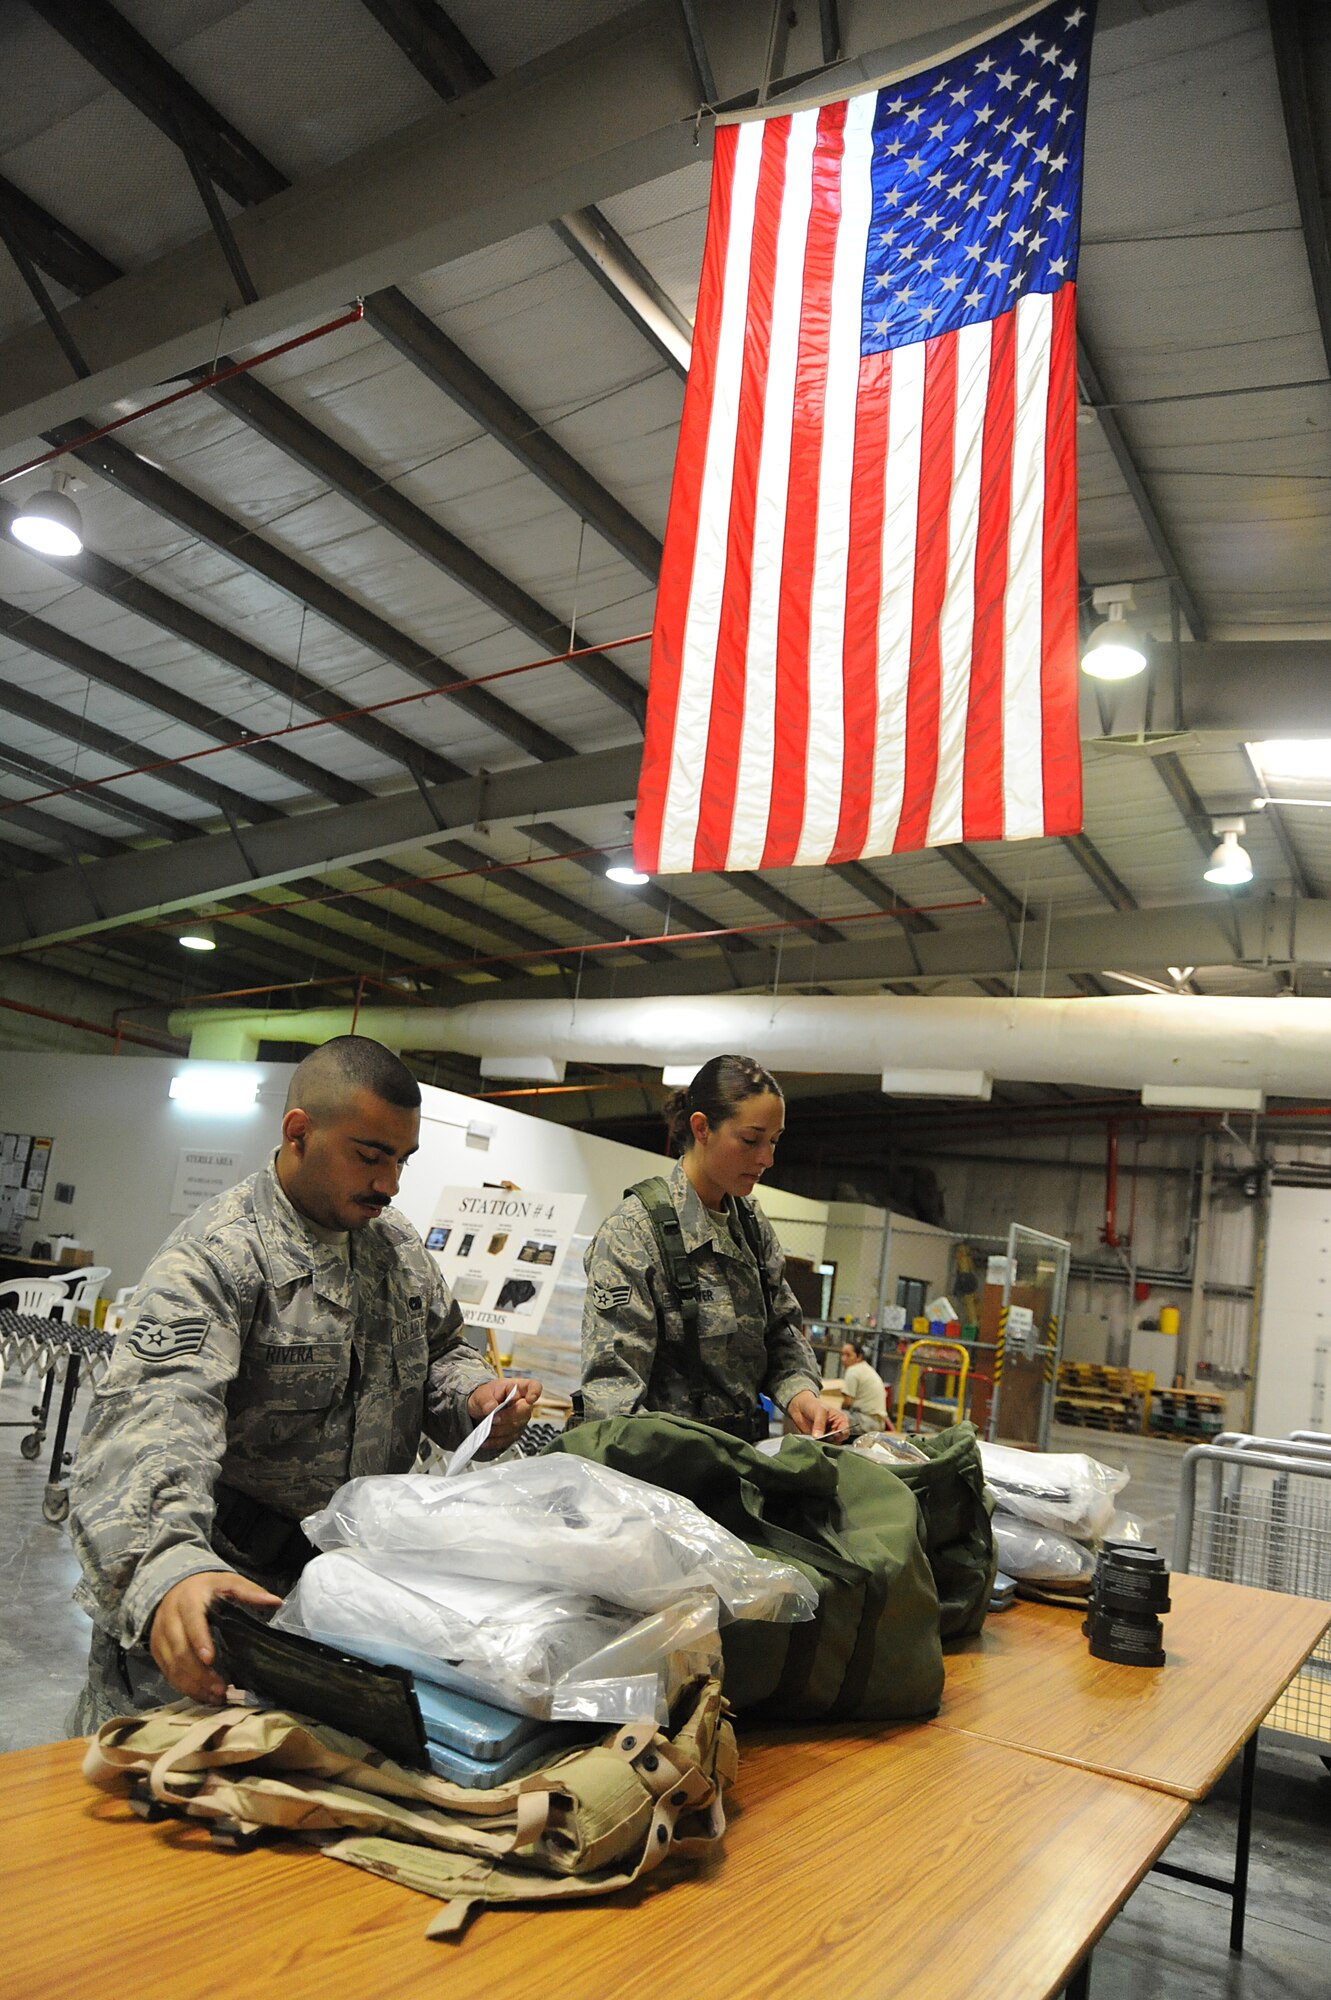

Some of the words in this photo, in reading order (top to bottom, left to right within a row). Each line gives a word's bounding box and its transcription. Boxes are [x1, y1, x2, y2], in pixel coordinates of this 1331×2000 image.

[458, 1196, 531, 1217] STATION
[477, 1311, 507, 1325] ITEMS
[265, 1346, 314, 1363] RIVERA
